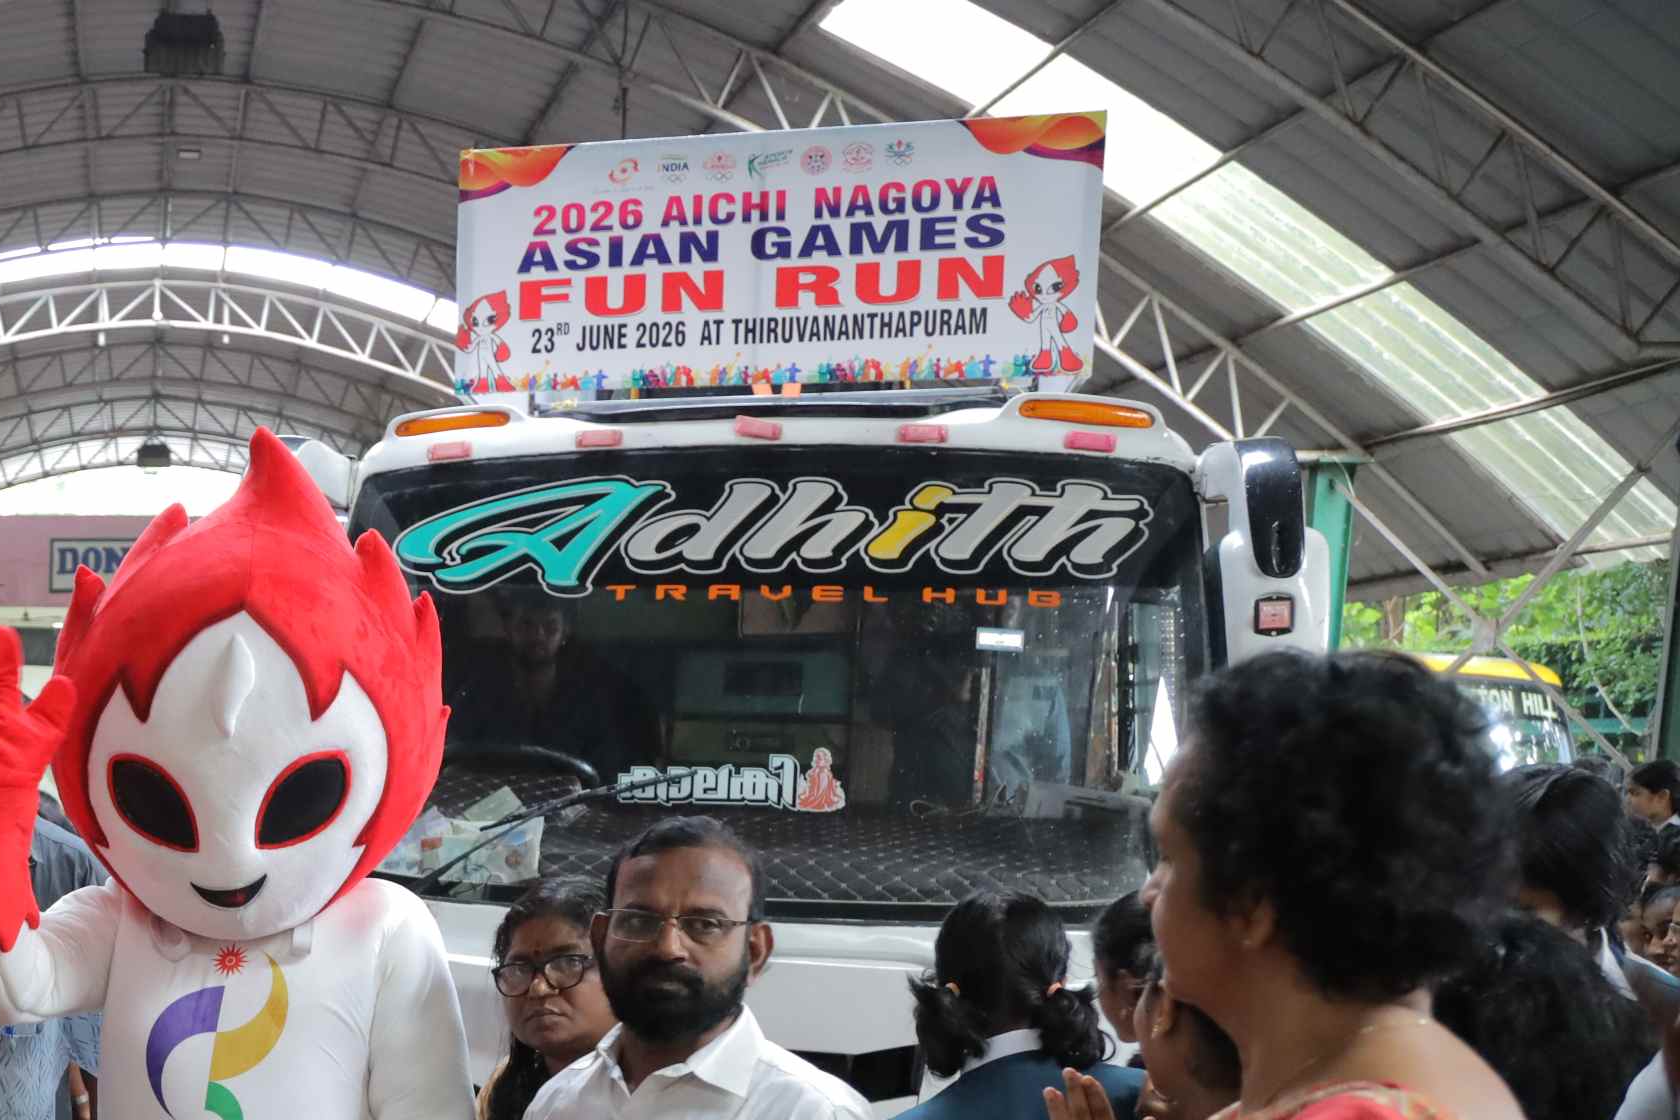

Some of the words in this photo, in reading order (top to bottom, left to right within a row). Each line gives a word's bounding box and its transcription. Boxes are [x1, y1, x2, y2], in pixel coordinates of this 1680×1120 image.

[532, 198, 643, 236] 2026
[660, 190, 787, 228] AICHI
[814, 176, 1002, 219] NAGOYA
[517, 230, 719, 274] ASIAN
[750, 213, 1006, 260] GAMES
[518, 270, 724, 321] FUN
[775, 255, 1005, 309] RUN
[576, 323, 628, 352] JUNE
[636, 320, 687, 348] 2026
[700, 319, 724, 346] AT
[732, 307, 988, 345] THIRUVANANTHAPURAM
[605, 584, 889, 603] TRAVEL
[922, 586, 1063, 607] HUB
[1521, 691, 1559, 720] HILL
